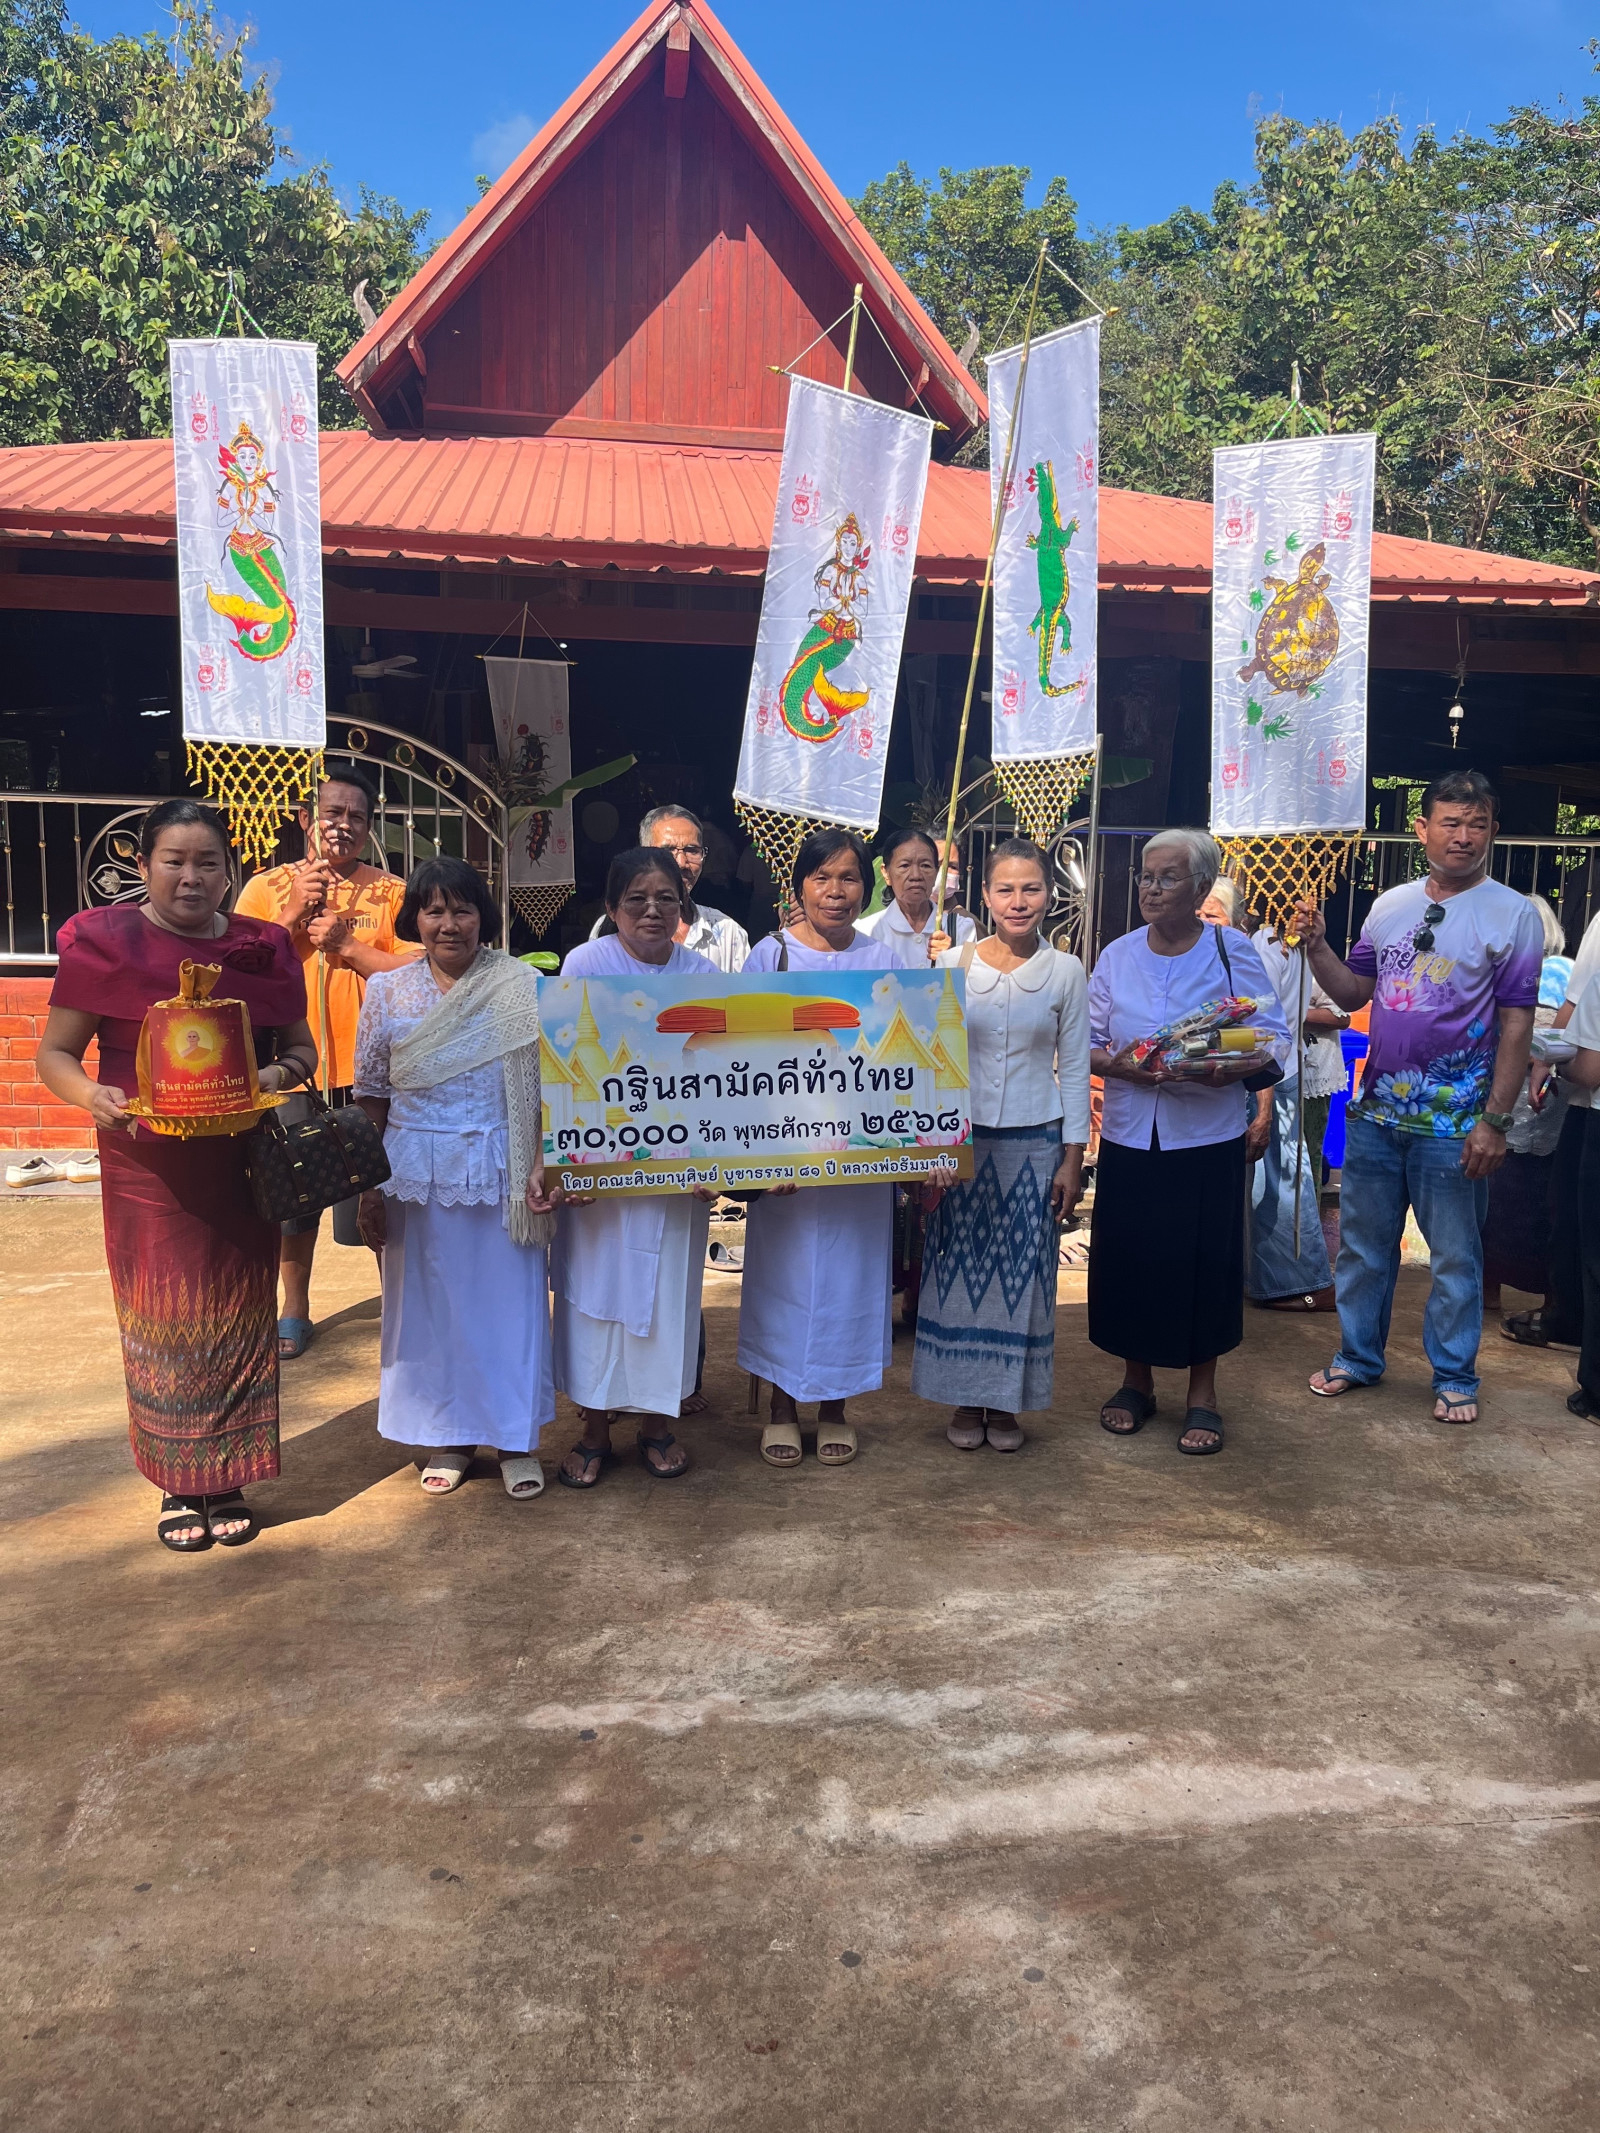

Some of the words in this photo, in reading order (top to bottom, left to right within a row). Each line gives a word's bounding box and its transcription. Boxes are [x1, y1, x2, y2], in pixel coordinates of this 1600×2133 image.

[602, 1047, 915, 1112] กฐินสามัคคีทั่วไทย
[557, 1123, 689, 1151] ๓๐,๐๐๐
[699, 1120, 726, 1143] วัด
[734, 1116, 852, 1150] พุทธศักราช
[861, 1107, 960, 1135] ๒๕๖๘
[563, 1174, 592, 1189] โดย
[599, 1165, 718, 1188] คณะศิษยานุศิษย์
[724, 1165, 793, 1185] บูชาธรรม
[800, 1166, 820, 1177] ๘๑
[826, 1161, 836, 1175] ปี
